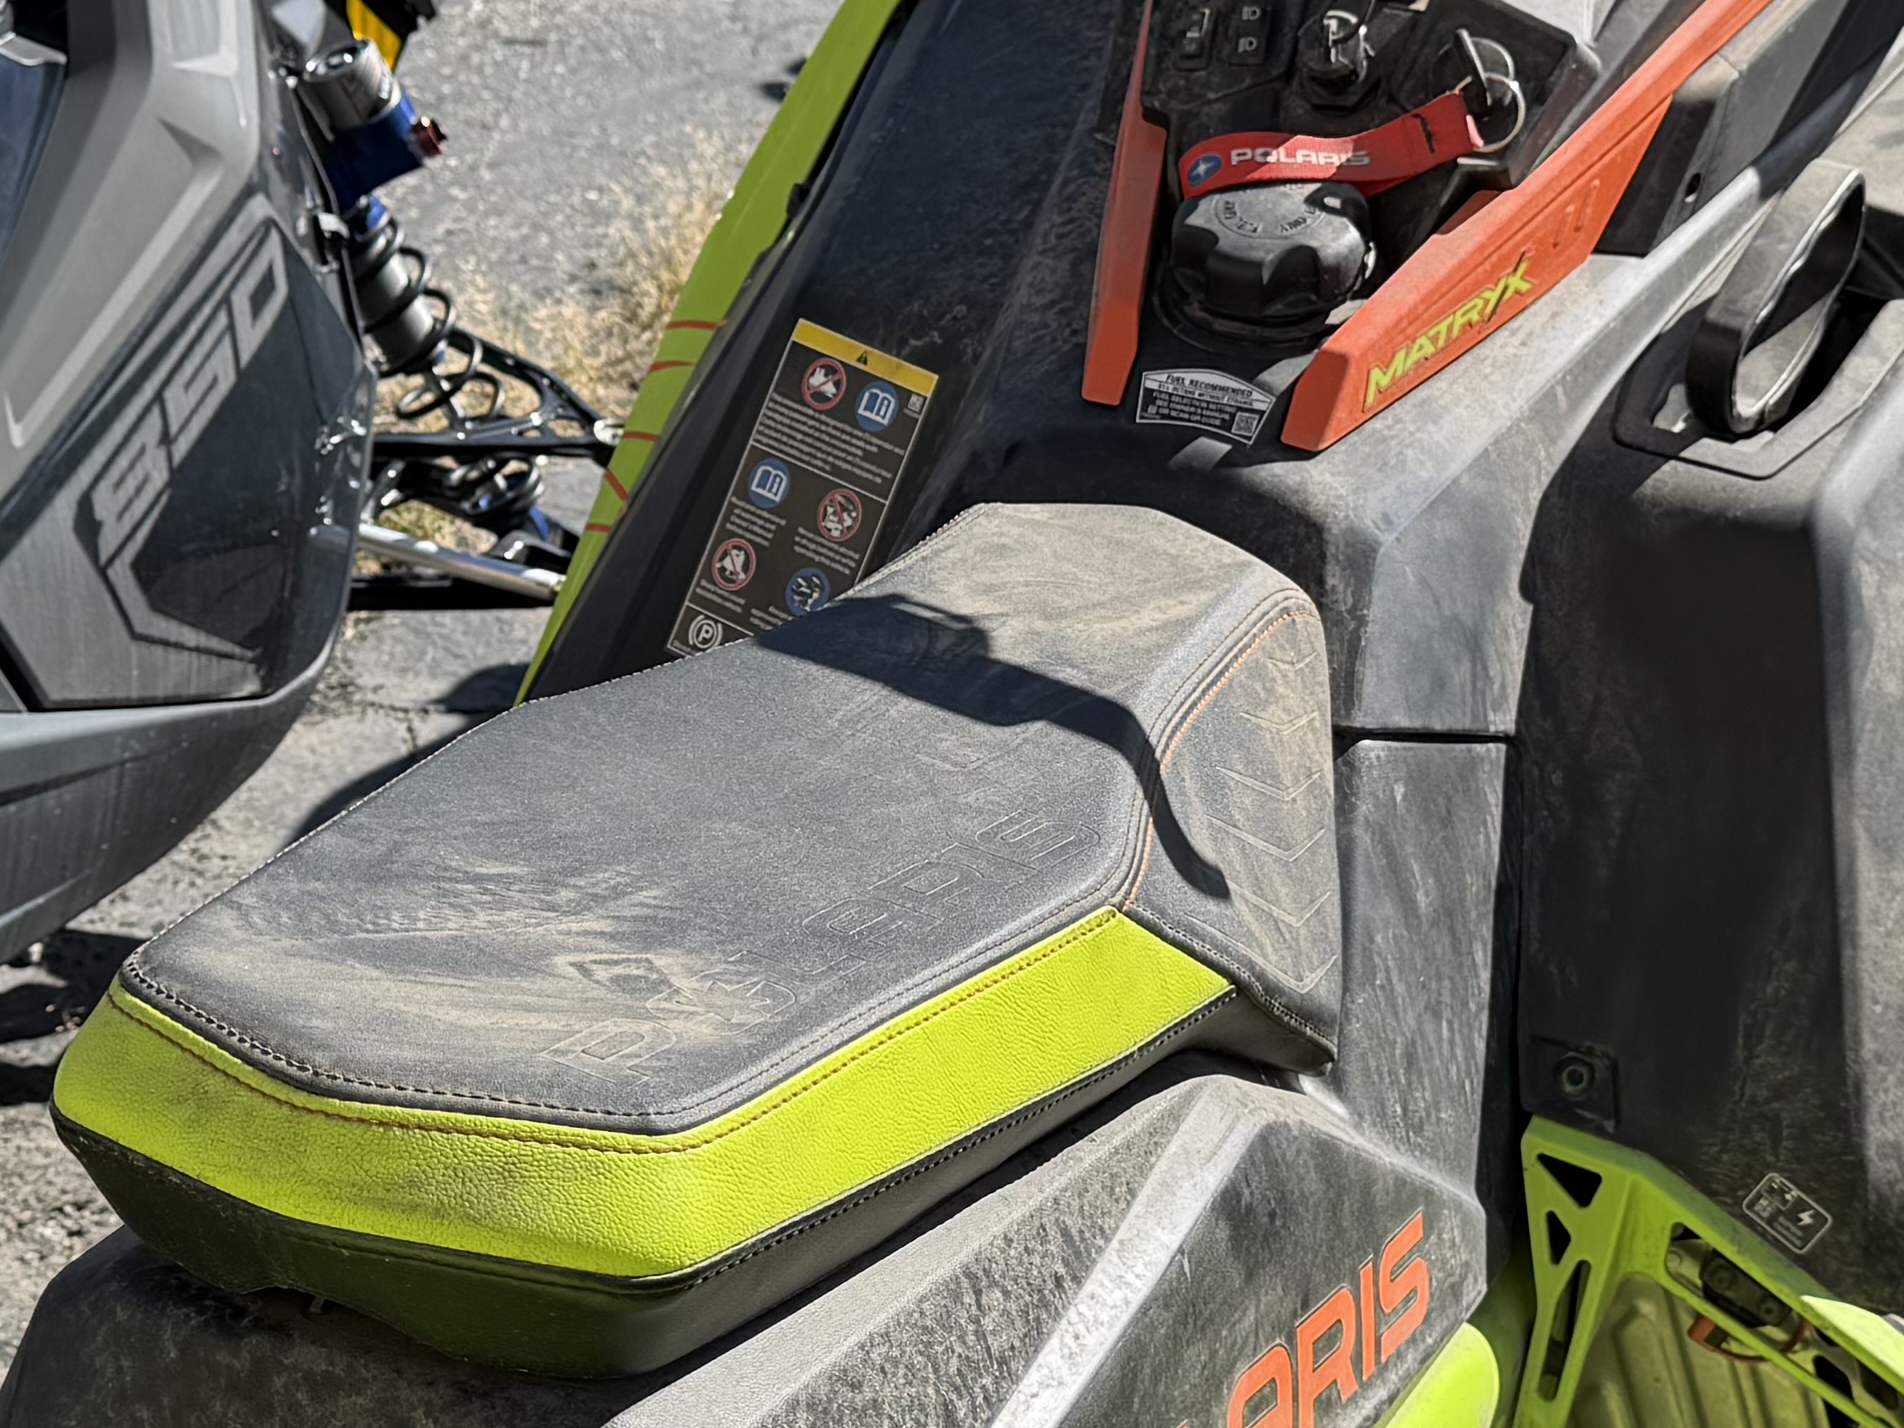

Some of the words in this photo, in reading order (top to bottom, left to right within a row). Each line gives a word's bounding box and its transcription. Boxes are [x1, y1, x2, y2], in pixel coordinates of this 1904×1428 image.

[1230, 146, 1370, 166] POLARIS
[1362, 253, 1536, 414] MATRYX
[86, 222, 288, 562] 850
[1166, 374, 1186, 386] FUEL
[1189, 378, 1254, 397] RECOMMENDED
